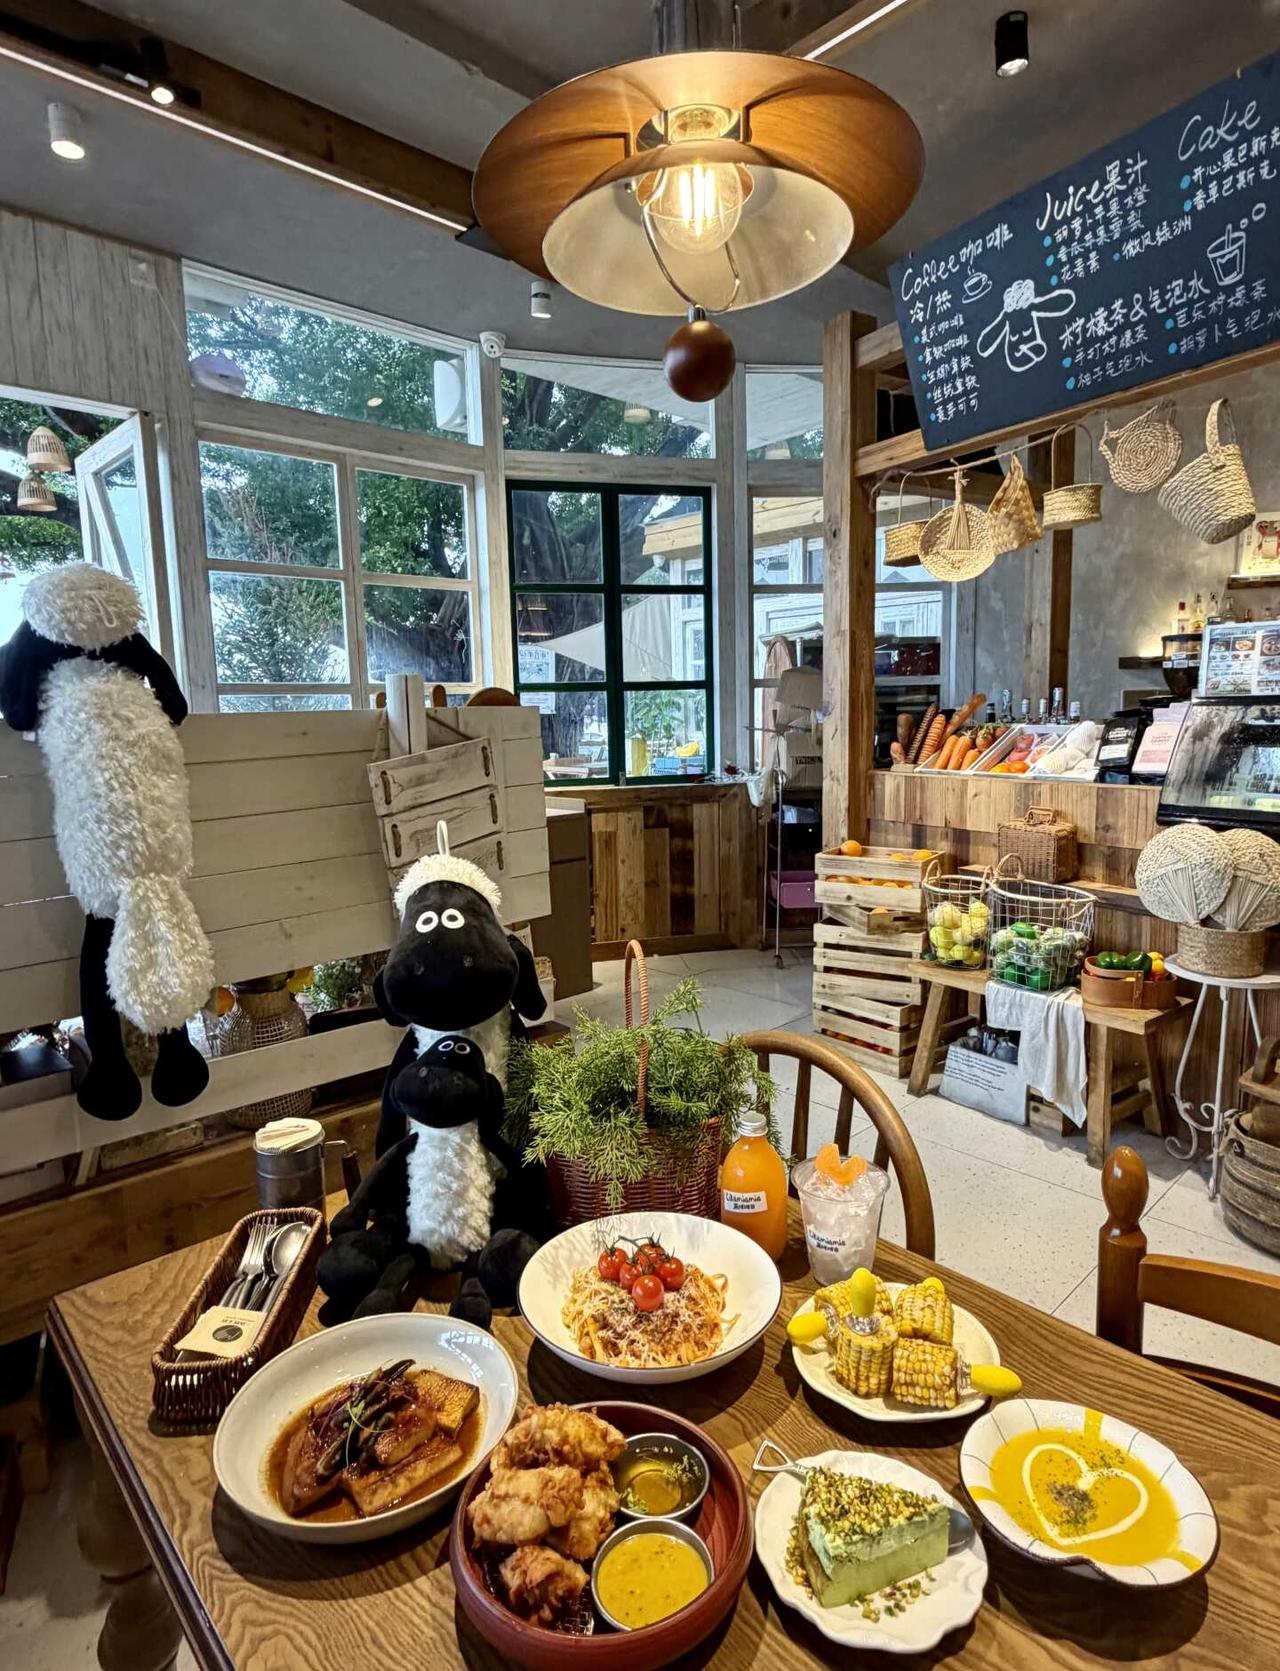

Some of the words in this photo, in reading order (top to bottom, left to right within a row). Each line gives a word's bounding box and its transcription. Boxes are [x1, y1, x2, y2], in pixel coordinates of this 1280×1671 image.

[1178, 98, 1261, 161] Cake
[1192, 160, 1277, 211] 香草巴斯克
